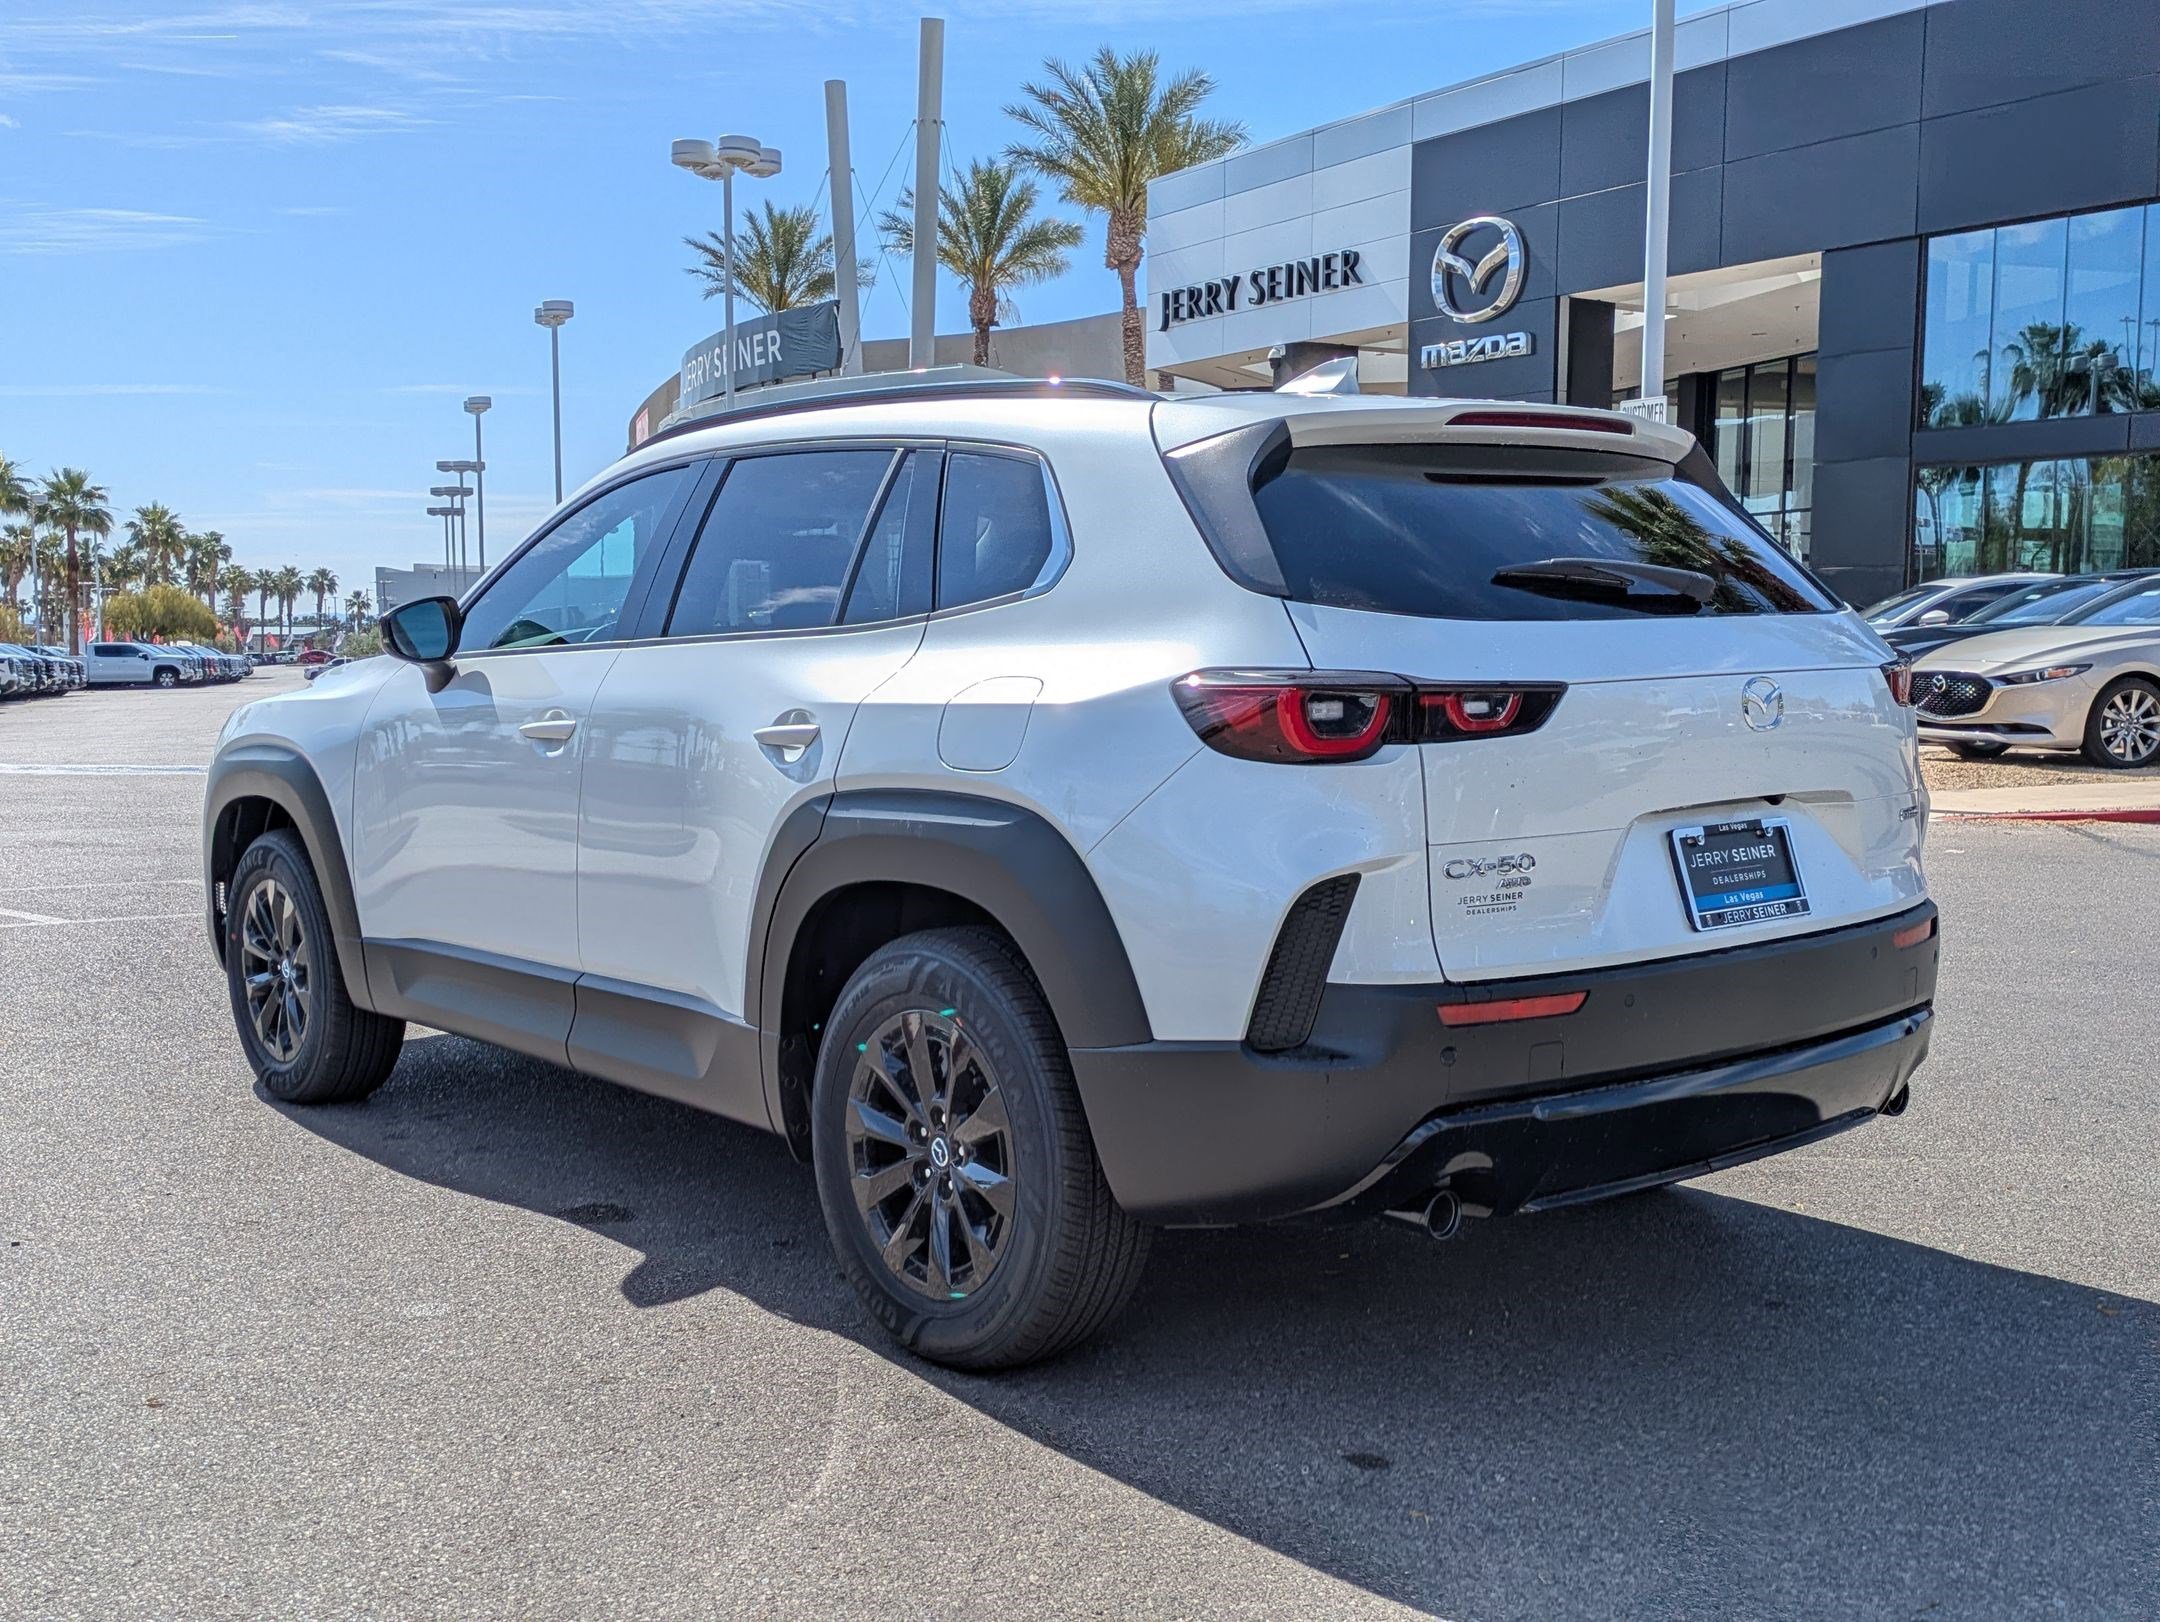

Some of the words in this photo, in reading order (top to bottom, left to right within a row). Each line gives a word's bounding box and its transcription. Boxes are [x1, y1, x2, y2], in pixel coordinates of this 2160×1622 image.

[1158, 275, 1241, 332] JERRY
[1248, 249, 1363, 306] SEINER
[1421, 331, 1533, 369] mazda
[683, 351, 712, 395] ERRY
[1622, 402, 1664, 424] STOMER
[1718, 824, 1730, 832] Las
[1730, 823, 1748, 831] Vegas
[1443, 852, 1536, 879] CX-50
[1690, 850, 1730, 868] JERRY
[1731, 844, 1776, 862] SEINER
[1496, 876, 1532, 889] AWD
[1712, 870, 1767, 885] DEALERSHIPS
[1457, 894, 1488, 906] JERRY
[1490, 891, 1524, 903] SEINER
[1724, 895, 1739, 904] Las
[1740, 890, 1764, 902] Vegas
[1466, 905, 1517, 916] DEALERSHIPS
[1723, 908, 1752, 924] JERRY
[1753, 903, 1788, 919] SEINER
